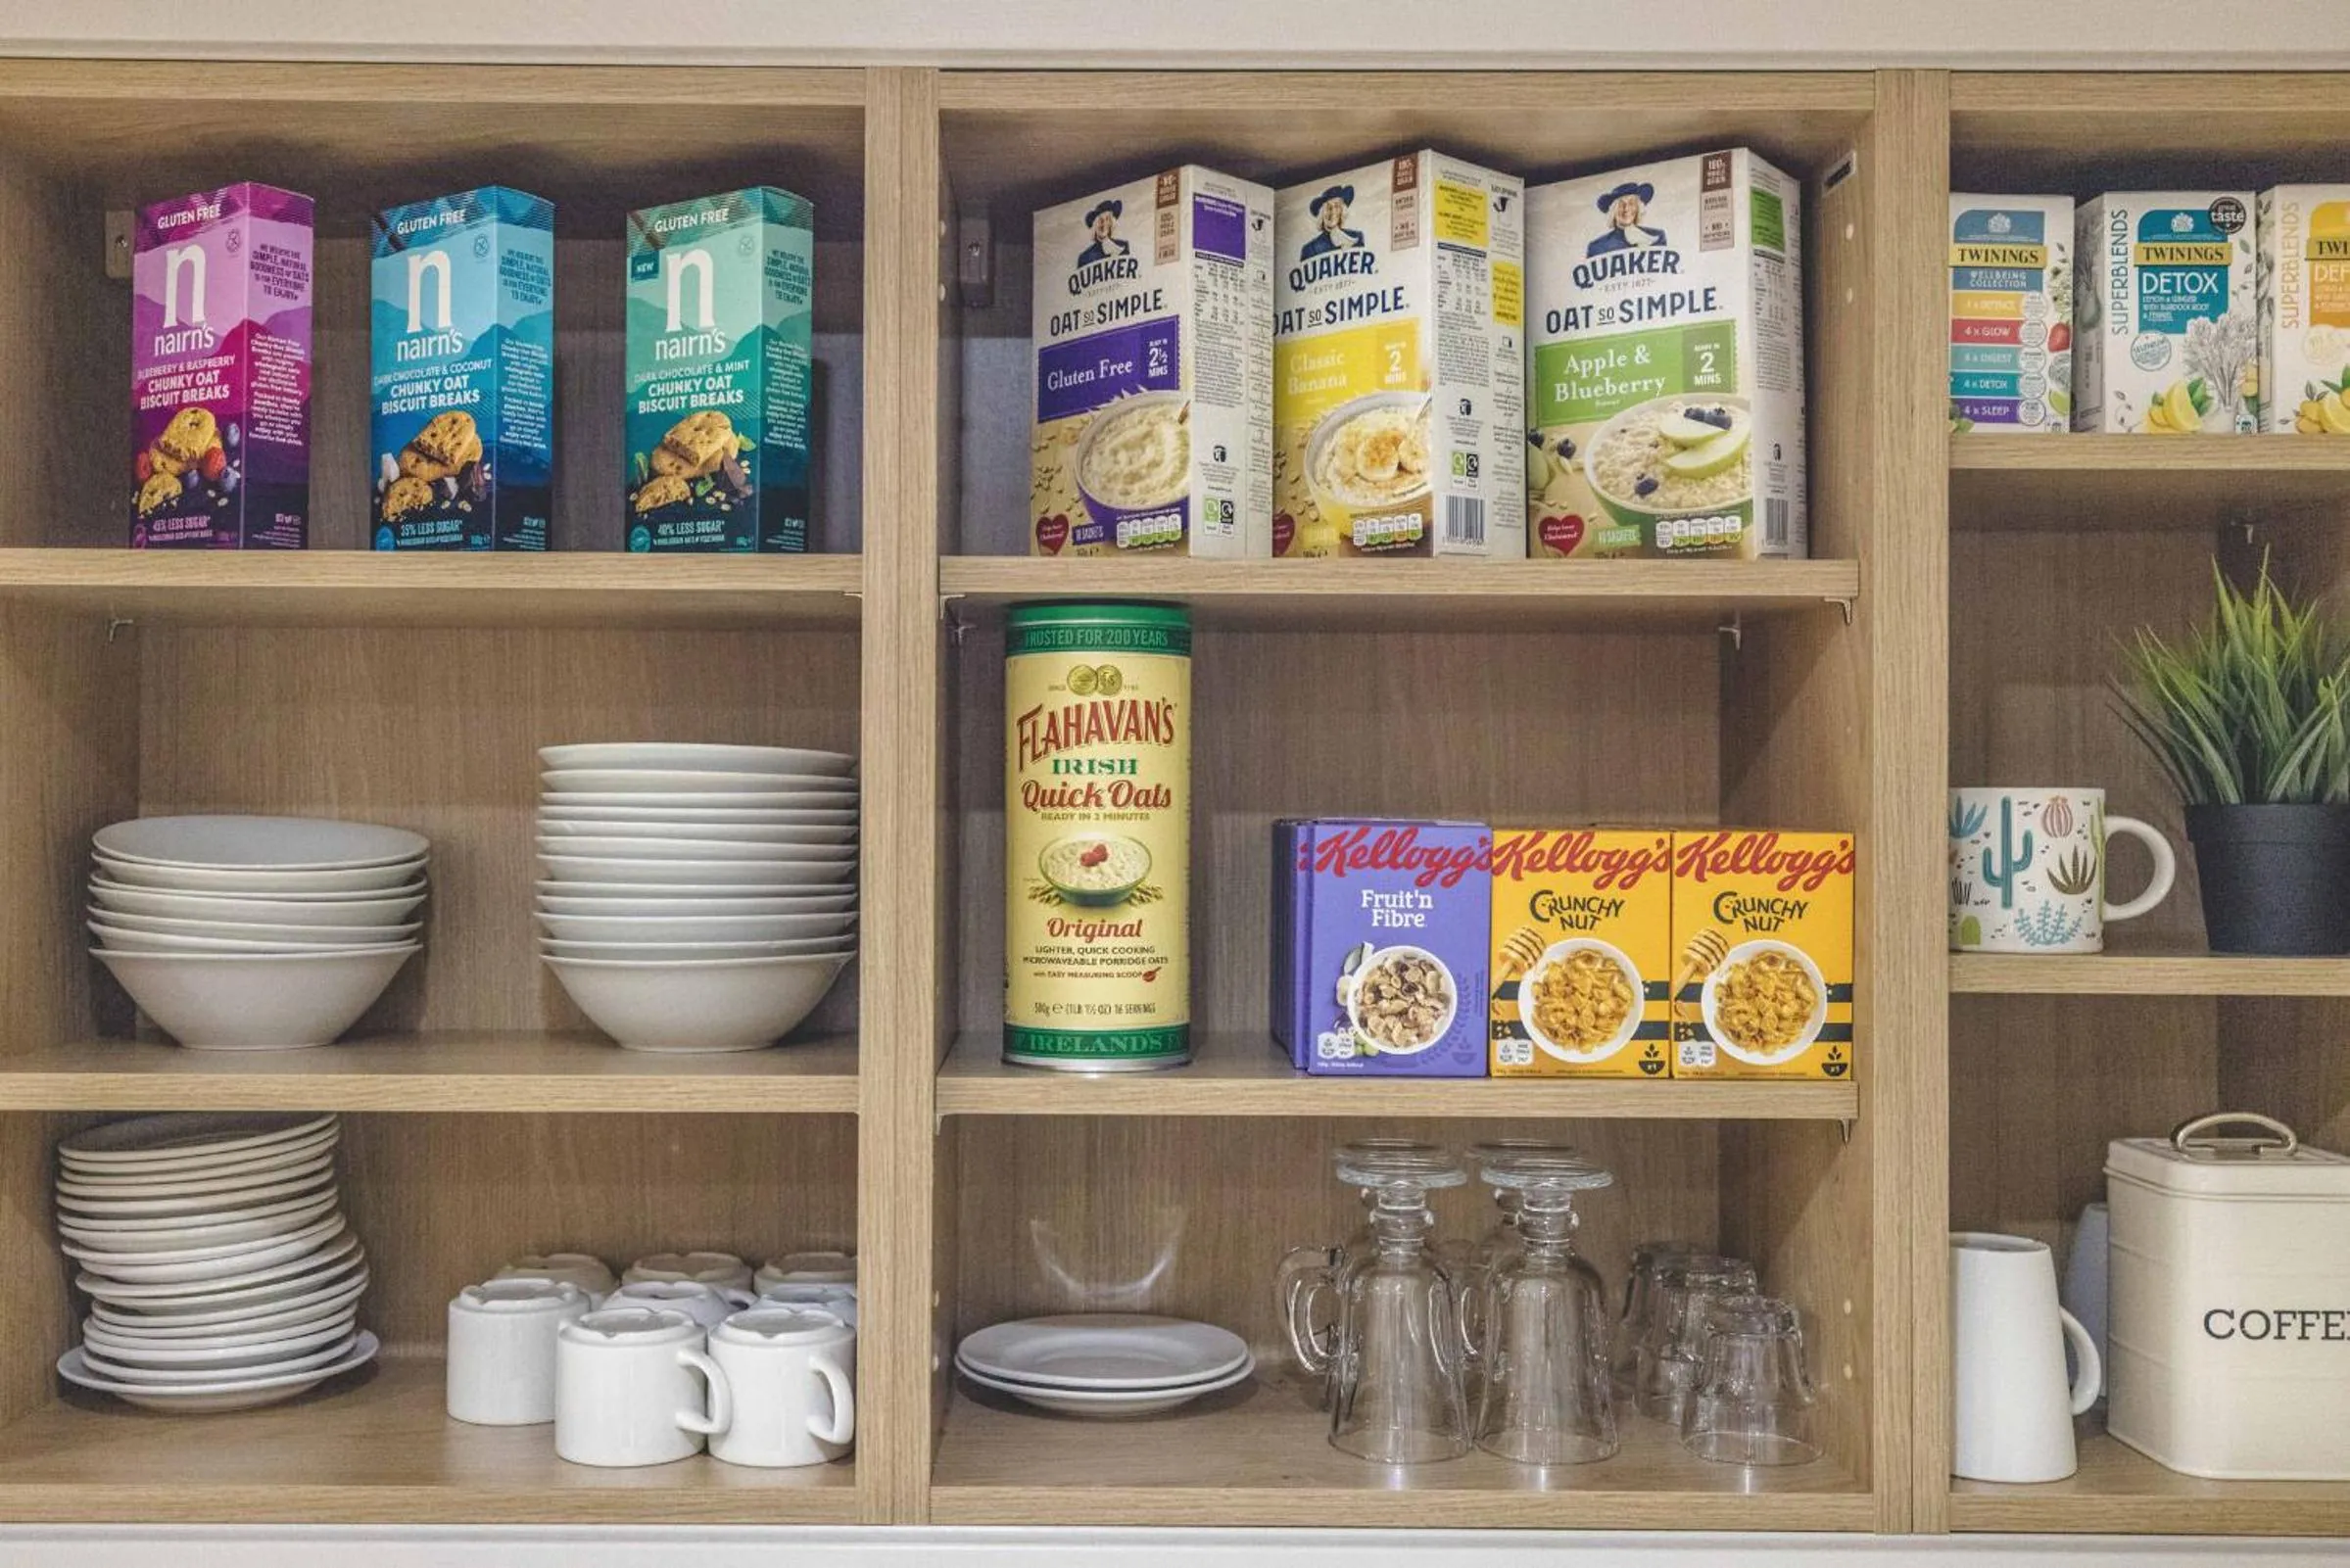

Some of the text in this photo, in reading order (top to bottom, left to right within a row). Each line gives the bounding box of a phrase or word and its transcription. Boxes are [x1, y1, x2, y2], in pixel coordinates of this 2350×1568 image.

[158, 204, 220, 229] GLUTEN FREE
[398, 210, 465, 234] GLUTEN FREE
[654, 208, 729, 232] GLUTEN FREE
[2212, 212, 2243, 222] taste
[1958, 248, 2038, 263] TWININGS
[2143, 247, 2224, 261] TWININGS
[2281, 202, 2299, 329] SUPERBLENDS
[637, 261, 654, 273] NEW
[1068, 258, 1138, 296] QUAKER
[1289, 252, 1375, 293] QUAKER
[1572, 251, 1680, 289] QUAKER
[1970, 270, 2026, 280] WELLBEING
[2112, 209, 2128, 335] SUPERBLENDS
[2142, 272, 2219, 294] DETOX
[1051, 309, 1080, 337] OAT
[1097, 289, 1163, 324] SIMPLE
[1309, 309, 1321, 323] SO
[1325, 286, 1404, 324] SIMPLE
[1546, 287, 1716, 334] OAT SO SIMPLE
[155, 324, 214, 356] nairn's
[1982, 327, 2010, 336] GLOW
[397, 329, 463, 361] nairn's
[655, 327, 725, 360] nairn's
[186, 355, 235, 371] RASPBERRY
[392, 365, 440, 383] CHOCOLATE
[450, 358, 493, 374] COCONUT
[658, 364, 713, 380] CHOCOLATE
[725, 360, 749, 372] MINT
[1148, 364, 1168, 378] MINS
[1290, 350, 1346, 374] Classic
[1389, 351, 1401, 371] 2
[1564, 345, 1651, 377] Apple &
[1701, 353, 1714, 372] 2
[149, 370, 219, 393] CHUNKY OAT
[391, 375, 469, 398] CHUNKY OAT
[648, 375, 733, 397] CHUNKY OAT
[1047, 359, 1132, 391] Gluten Free
[1287, 373, 1347, 395] Banana
[1694, 373, 1721, 385] MINS
[1980, 380, 2007, 389] DETOX
[140, 385, 229, 409] BISCUIT BREAKS
[639, 390, 743, 413] BISCUIT BREAKS
[1555, 377, 1665, 403] Blueberry
[382, 390, 480, 414] BISCUIT BREAKS
[1982, 406, 2009, 415] SLEEP
[168, 518, 183, 530] LESS
[417, 521, 435, 534] LESS
[676, 522, 695, 534] LESS
[1027, 628, 1168, 646] TRUSTED FOR 200 YEARS
[1017, 696, 1174, 774] FLAHAVAN'S
[1052, 759, 1137, 775] IRISH
[1022, 780, 1172, 811] Quick Oats
[1103, 812, 1150, 821] MINUTES
[1316, 827, 1493, 888] Kellogg's
[1491, 831, 1670, 890] Kellogg's
[1675, 832, 1854, 892] Kellogg's
[1361, 888, 1434, 910] Fruit'n
[1529, 889, 1625, 923] CRUNCHY
[1712, 890, 1809, 925] CRUNCHY
[1371, 909, 1425, 927] Fibre
[1559, 913, 1602, 931] NUT
[1743, 916, 1785, 932] NUT
[1047, 918, 1143, 943] Original
[1023, 957, 1097, 966] MICROWAVEABLE
[2204, 1308, 2350, 1341] COFFE
